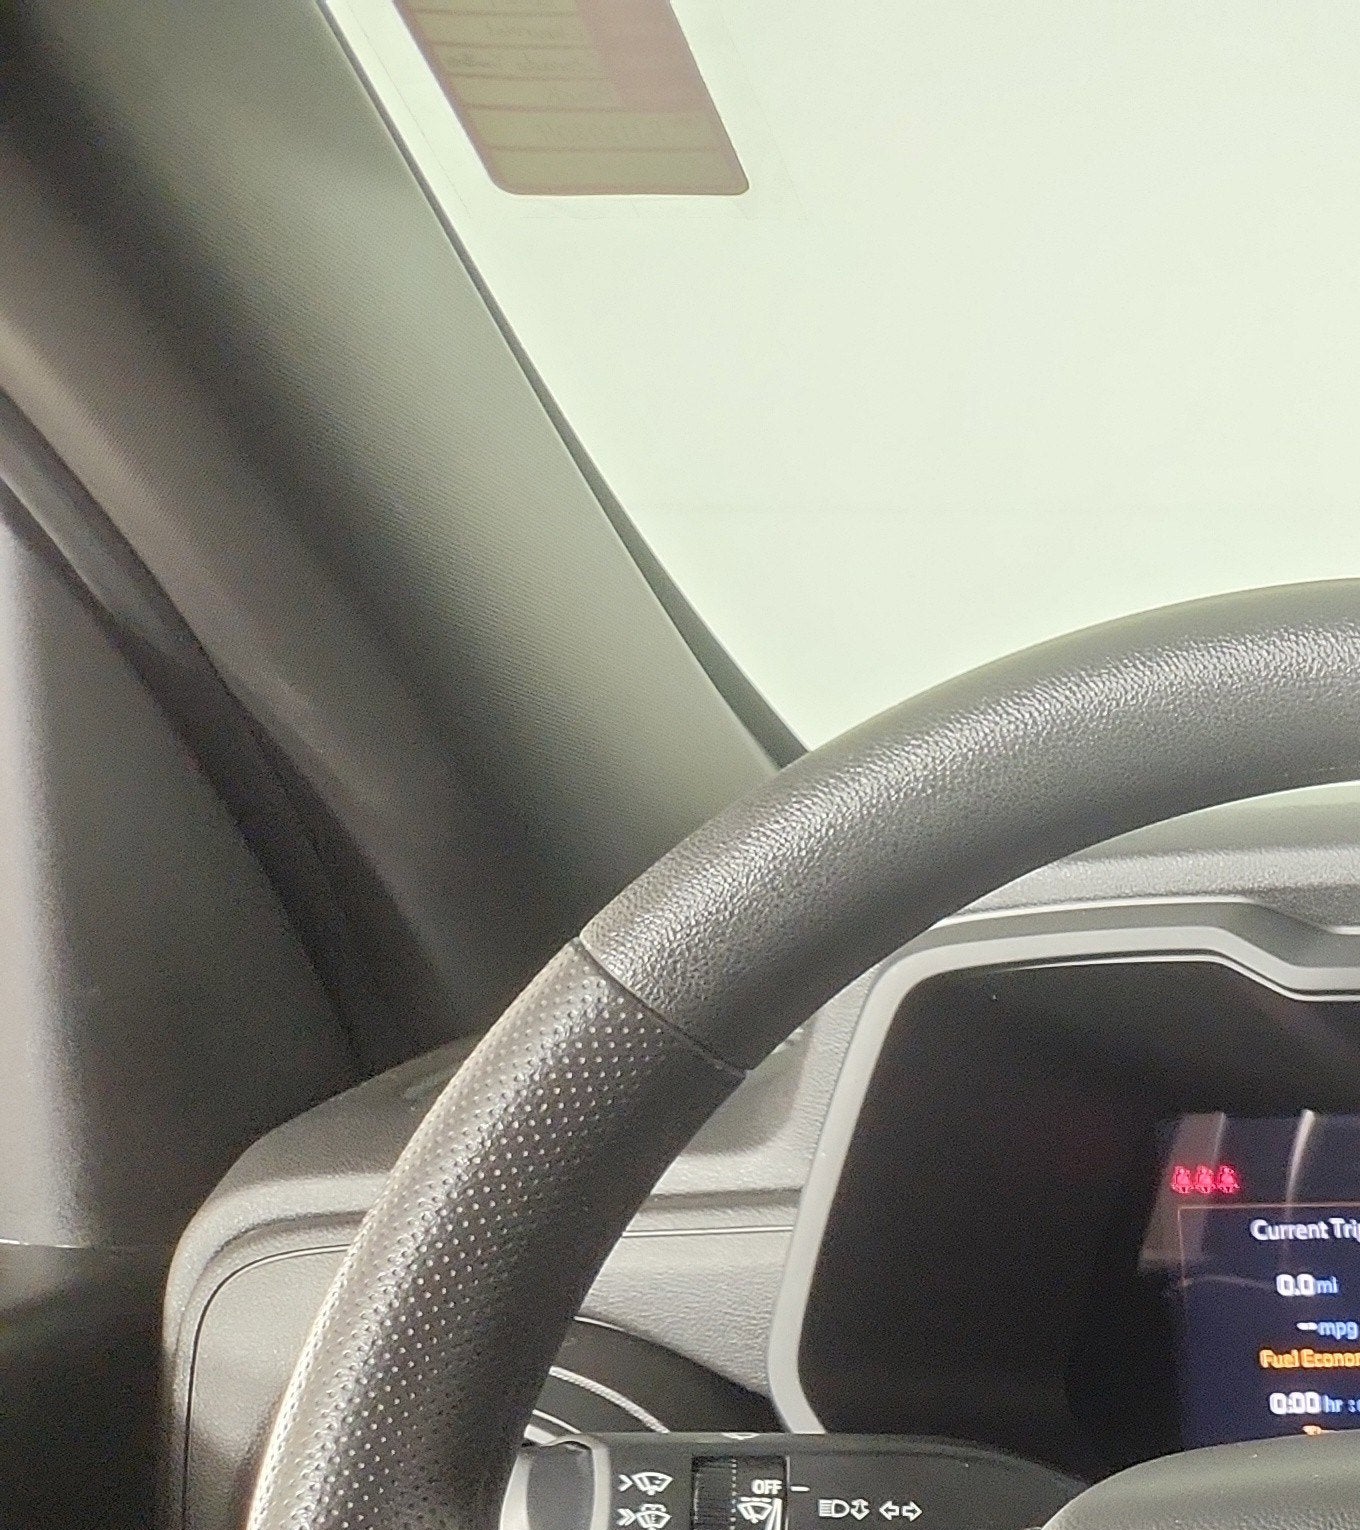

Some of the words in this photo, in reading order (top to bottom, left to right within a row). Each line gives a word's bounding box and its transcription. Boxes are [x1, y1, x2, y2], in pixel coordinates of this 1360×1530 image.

[1250, 1218, 1329, 1240] Current
[1259, 1349, 1300, 1368] Fuel
[751, 1479, 783, 1495] OFF
